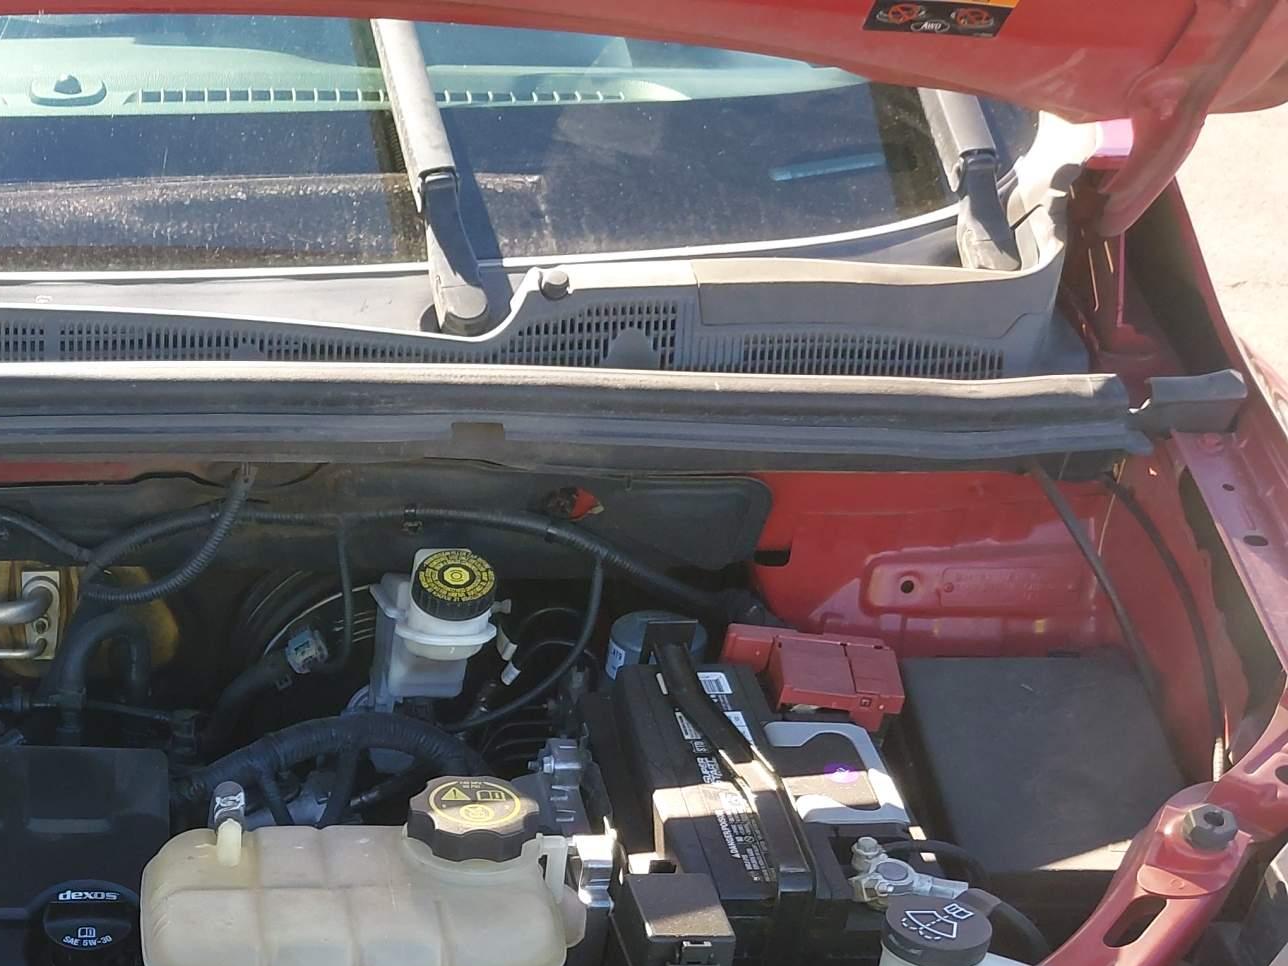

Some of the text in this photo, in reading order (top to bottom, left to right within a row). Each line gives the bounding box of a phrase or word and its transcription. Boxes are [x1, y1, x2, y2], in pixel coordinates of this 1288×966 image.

[696, 757, 712, 784] SUPER
[58, 890, 120, 901] dexos
[63, 935, 112, 947] SAE 5W-30
